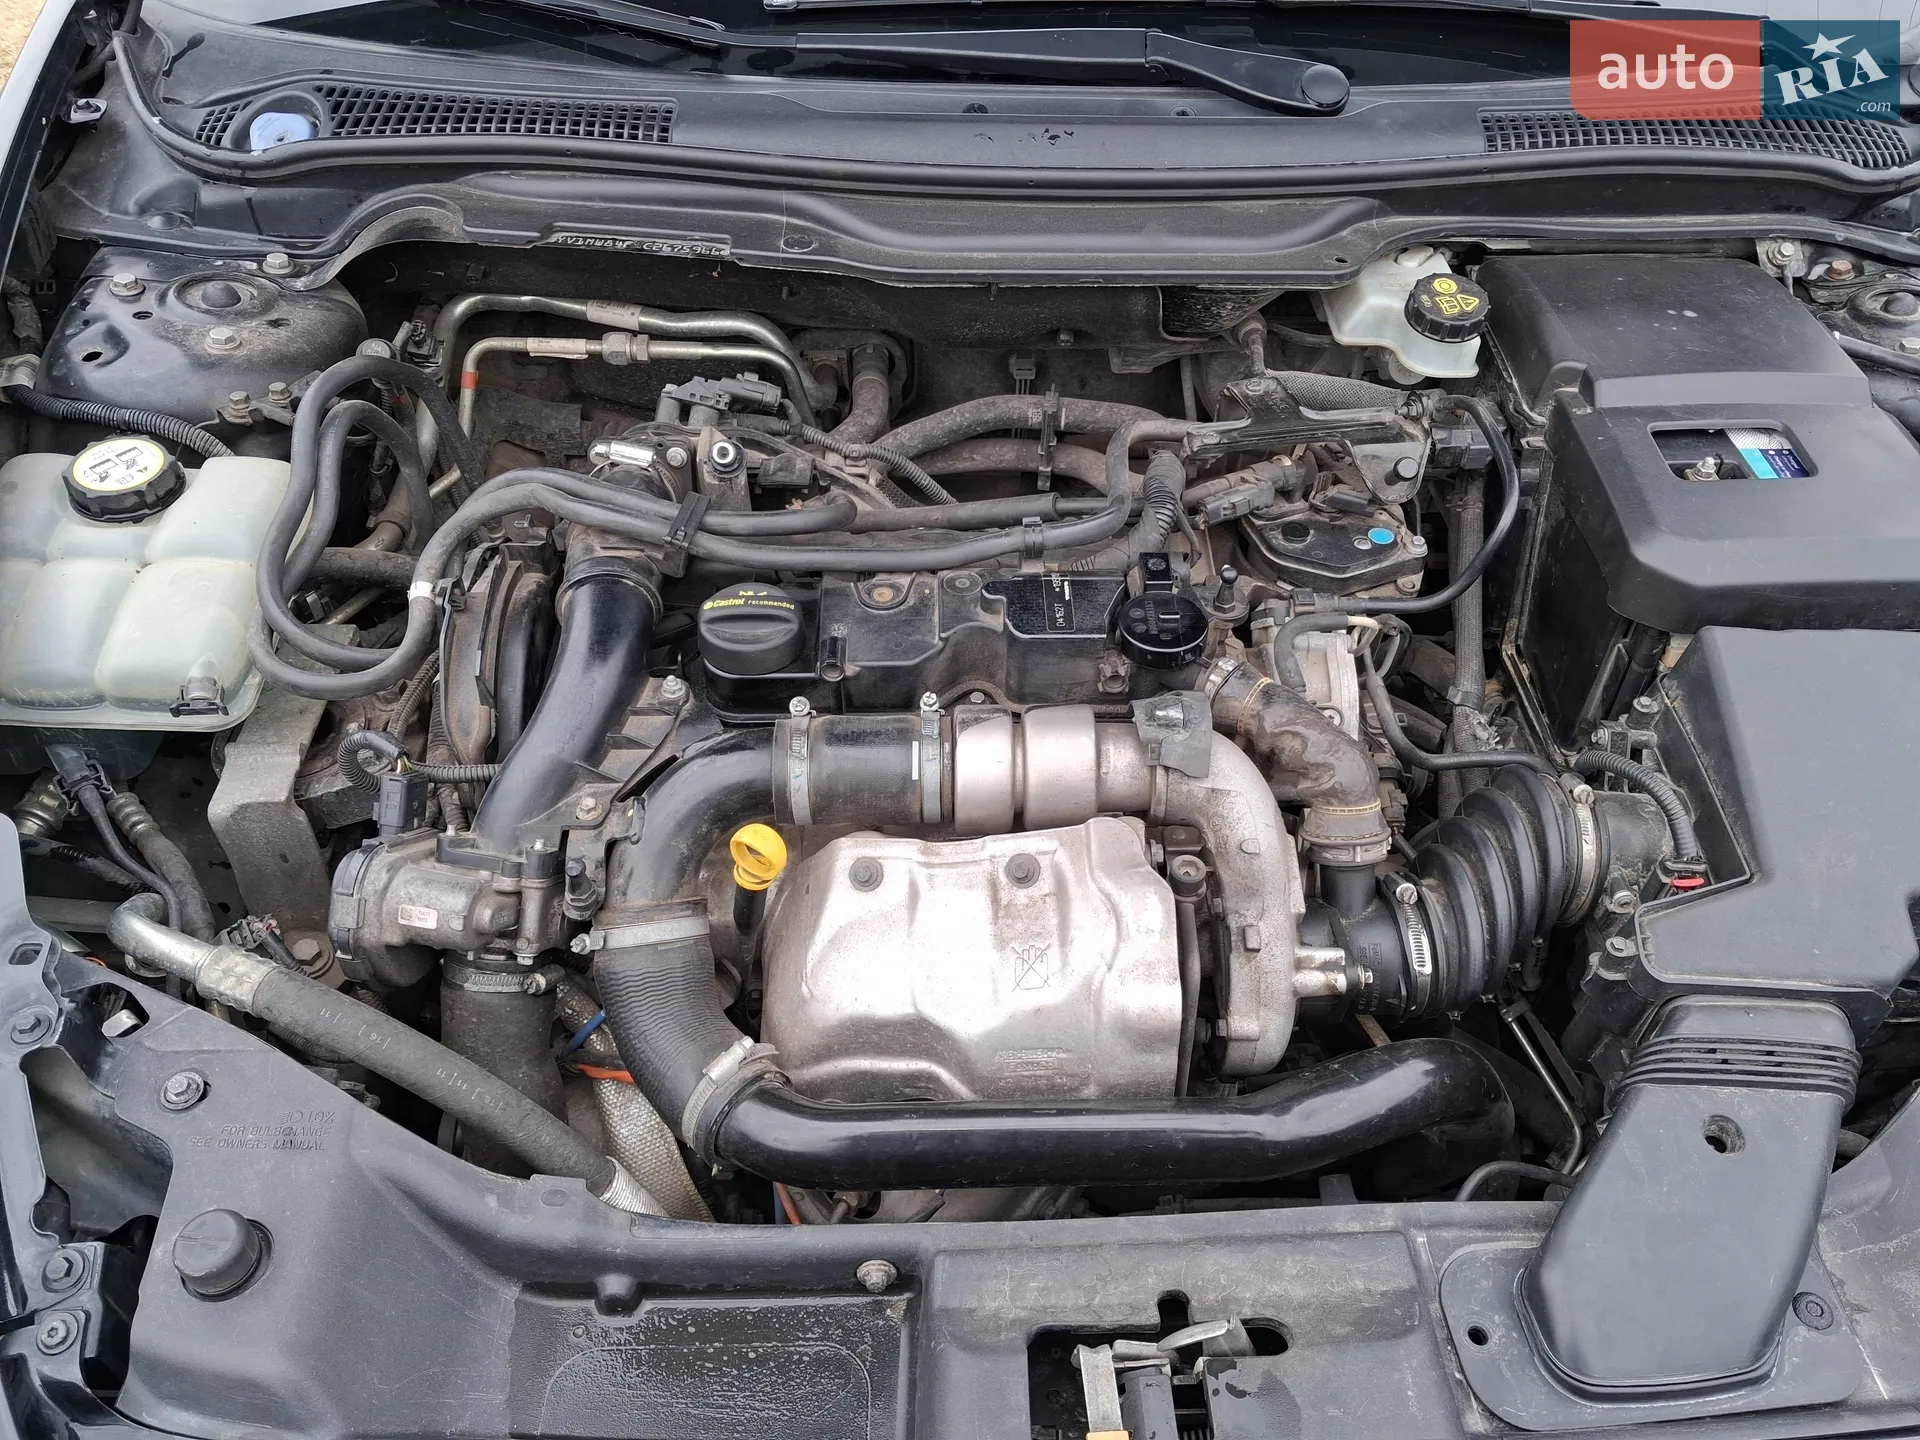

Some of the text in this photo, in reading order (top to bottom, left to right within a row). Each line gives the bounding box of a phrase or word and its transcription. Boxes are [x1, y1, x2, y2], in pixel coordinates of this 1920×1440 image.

[713, 598, 795, 610] Castrol recommended
[220, 1125, 246, 1136] FOR
[188, 1136, 326, 1151] SEE OWNERS MANUAL
